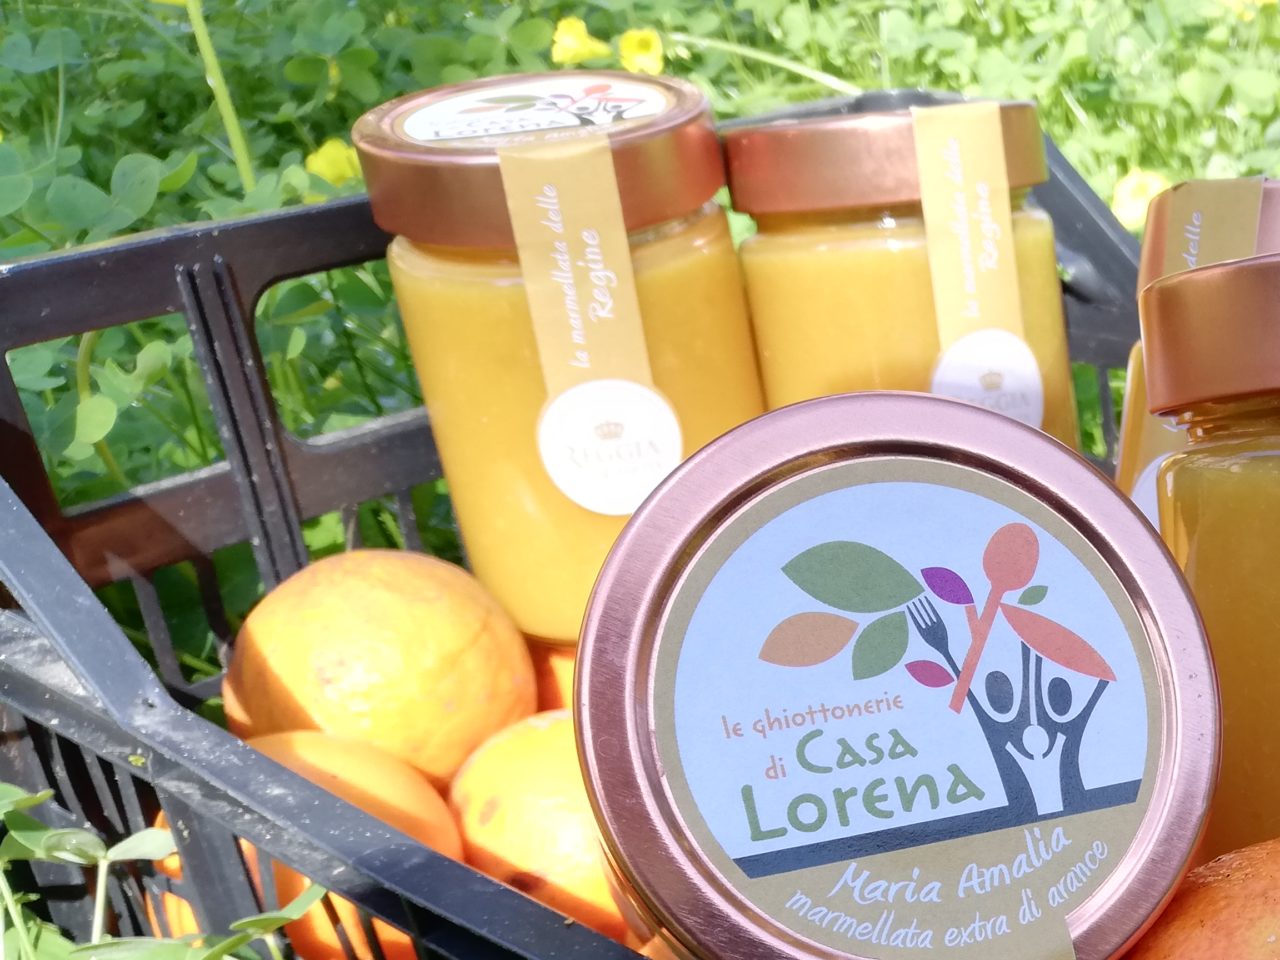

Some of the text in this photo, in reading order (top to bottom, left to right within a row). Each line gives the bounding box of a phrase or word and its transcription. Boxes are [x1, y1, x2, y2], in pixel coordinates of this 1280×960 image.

[533, 183, 591, 368] la marmellata delle
[577, 228, 618, 323] Regine
[1182, 209, 1202, 268] delle
[721, 692, 904, 739] le ghiottonerie
[764, 728, 919, 780] di Casa
[785, 840, 1108, 950] marmellata extra di arance
[827, 825, 1072, 905] Maria Amalia
